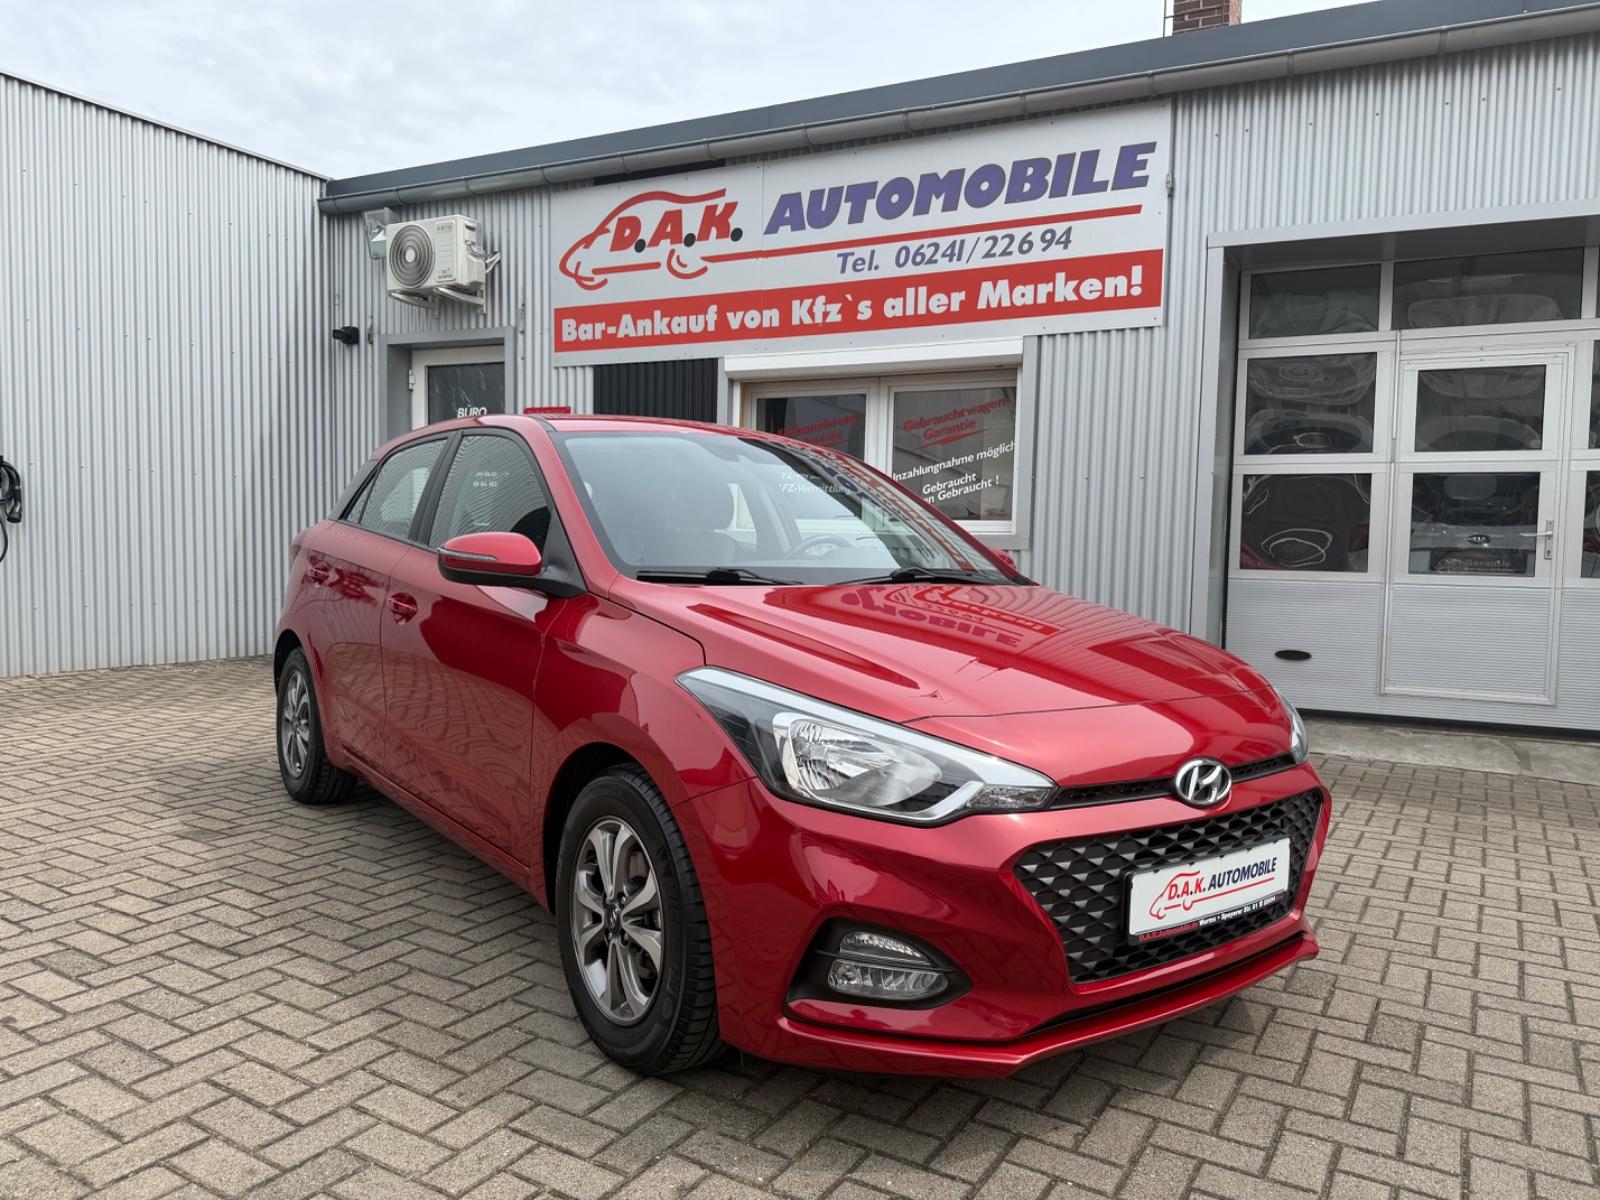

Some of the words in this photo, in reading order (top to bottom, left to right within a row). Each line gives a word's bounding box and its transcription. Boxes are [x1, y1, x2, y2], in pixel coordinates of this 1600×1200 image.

[609, 201, 743, 253] D.A.K.
[763, 141, 1157, 235] AUTOMOBILE
[837, 249, 879, 274] Tel.
[561, 304, 718, 342] Bar-Ankauf
[726, 308, 780, 330] von
[883, 286, 966, 318] aller
[977, 264, 1143, 310] Marken!
[923, 418, 977, 439] Garantie
[922, 473, 976, 495] Gebraucht
[938, 479, 993, 501] Gebraucht
[1208, 857, 1277, 891] AUTOMOBILE
